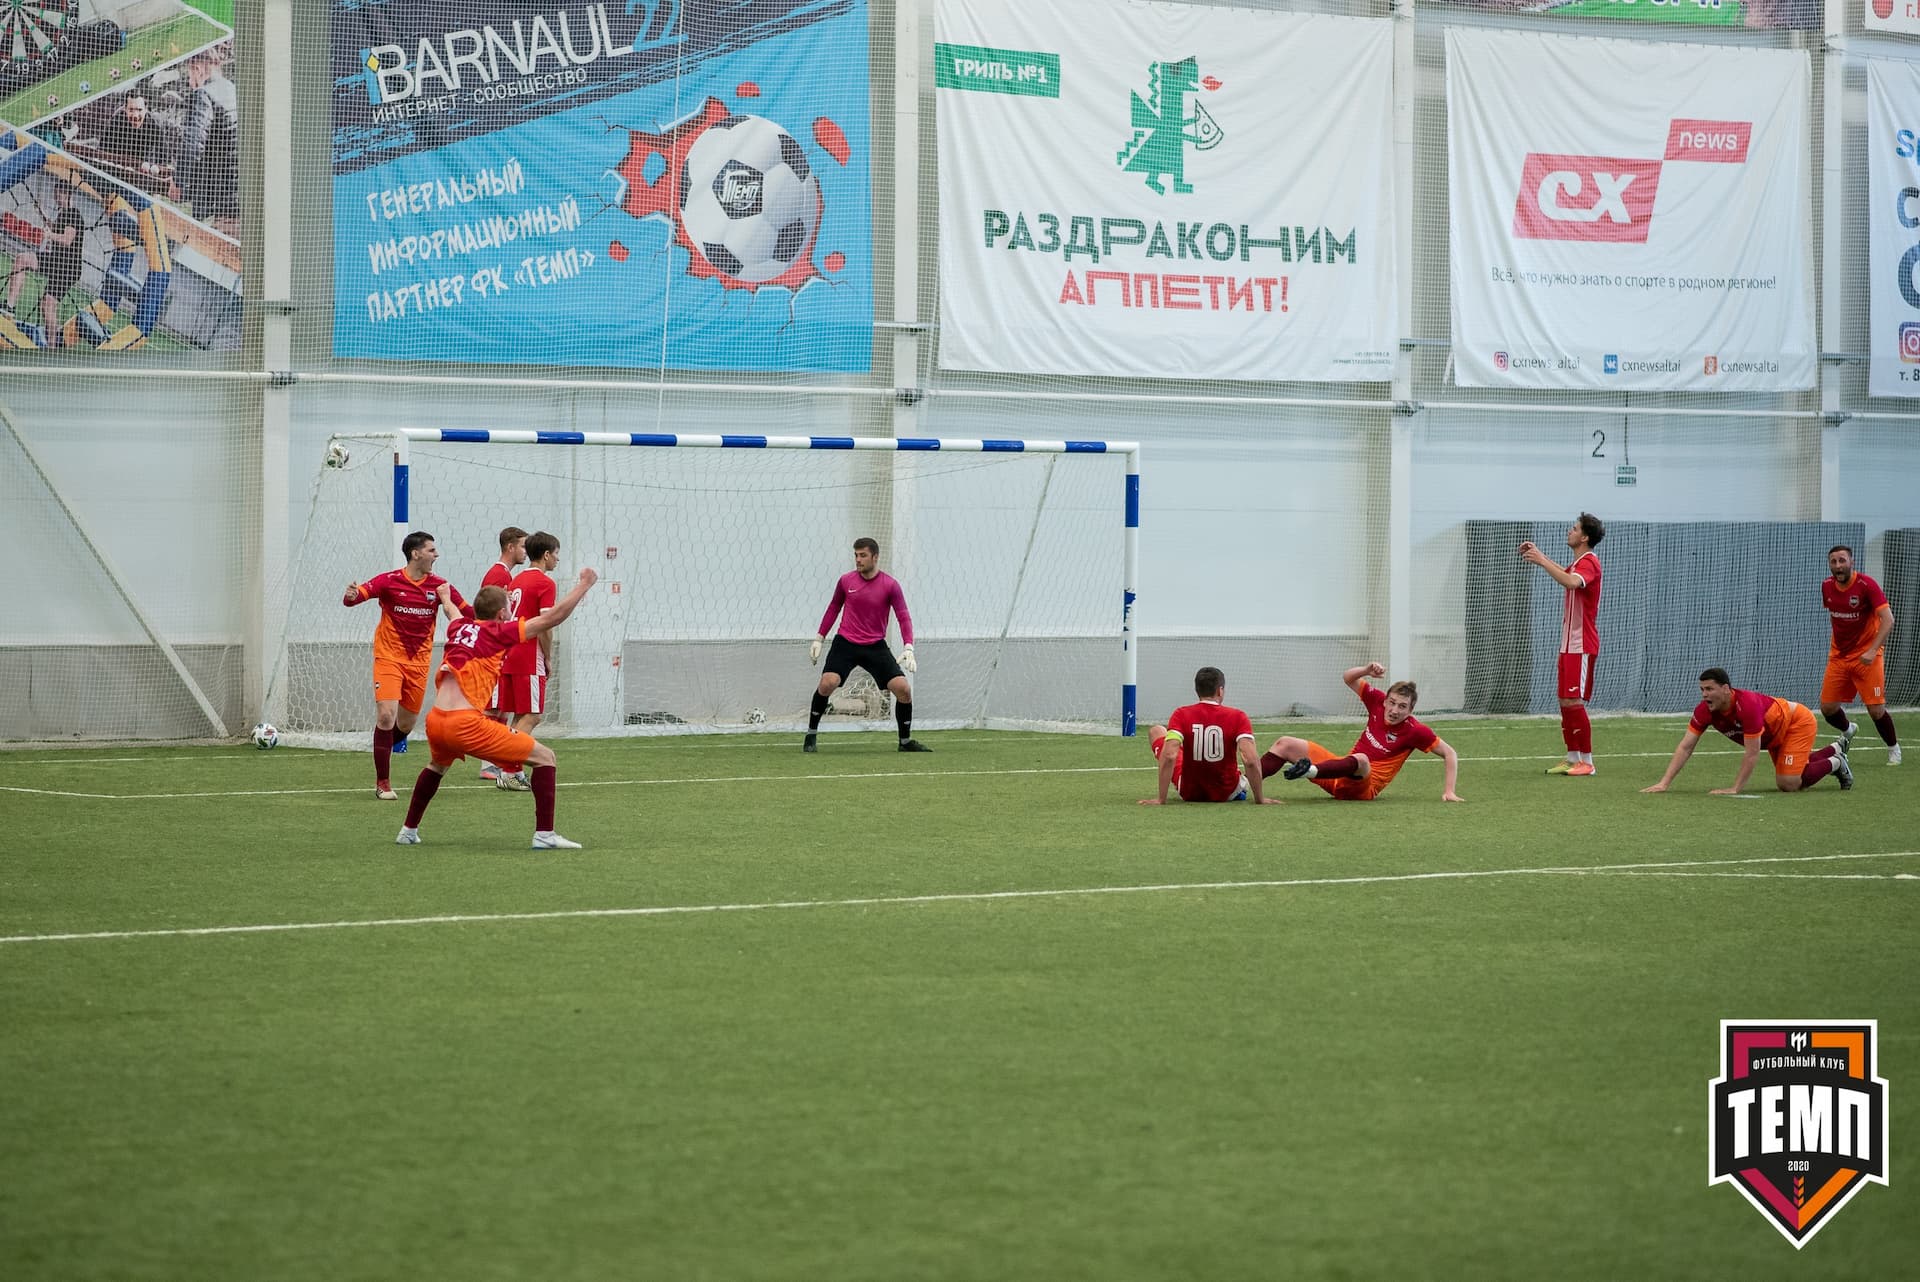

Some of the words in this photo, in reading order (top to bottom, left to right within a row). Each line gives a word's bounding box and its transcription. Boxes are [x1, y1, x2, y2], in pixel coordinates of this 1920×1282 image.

[954, 58, 1013, 80] ГРИЛЬ
[1018, 65, 1048, 83] №1
[372, 92, 458, 124] ИНТЕРНЕТ
[473, 68, 586, 105] СООБЩЕСТВО
[1680, 131, 1738, 150] news
[366, 157, 525, 221] ГЕНЕРАЛЬНЫЙ
[368, 194, 581, 275] ИНФОРМАЦИОННЫЙ
[983, 209, 1357, 264] РАЗДРАКОНИМ
[367, 274, 465, 322] ПАРТНЕР
[471, 264, 509, 298] ФК
[514, 247, 596, 287] «ТЕМП»
[1058, 269, 1288, 313] АППЕТИТ!
[1491, 266, 1515, 284] Всё,
[1519, 271, 1538, 284] что
[1540, 272, 1577, 287] нужно
[1580, 275, 1612, 286] знать
[1614, 275, 1622, 287] о
[1625, 275, 1665, 290] спорте
[1669, 278, 1675, 288] в
[1679, 277, 1725, 291] родном
[1728, 276, 1777, 291] регионе!
[1622, 359, 1681, 373] cxnewsaltai
[1721, 359, 1779, 373] cxnewsaltai
[1592, 429, 1605, 458] 2
[1192, 723, 1225, 762] 10
